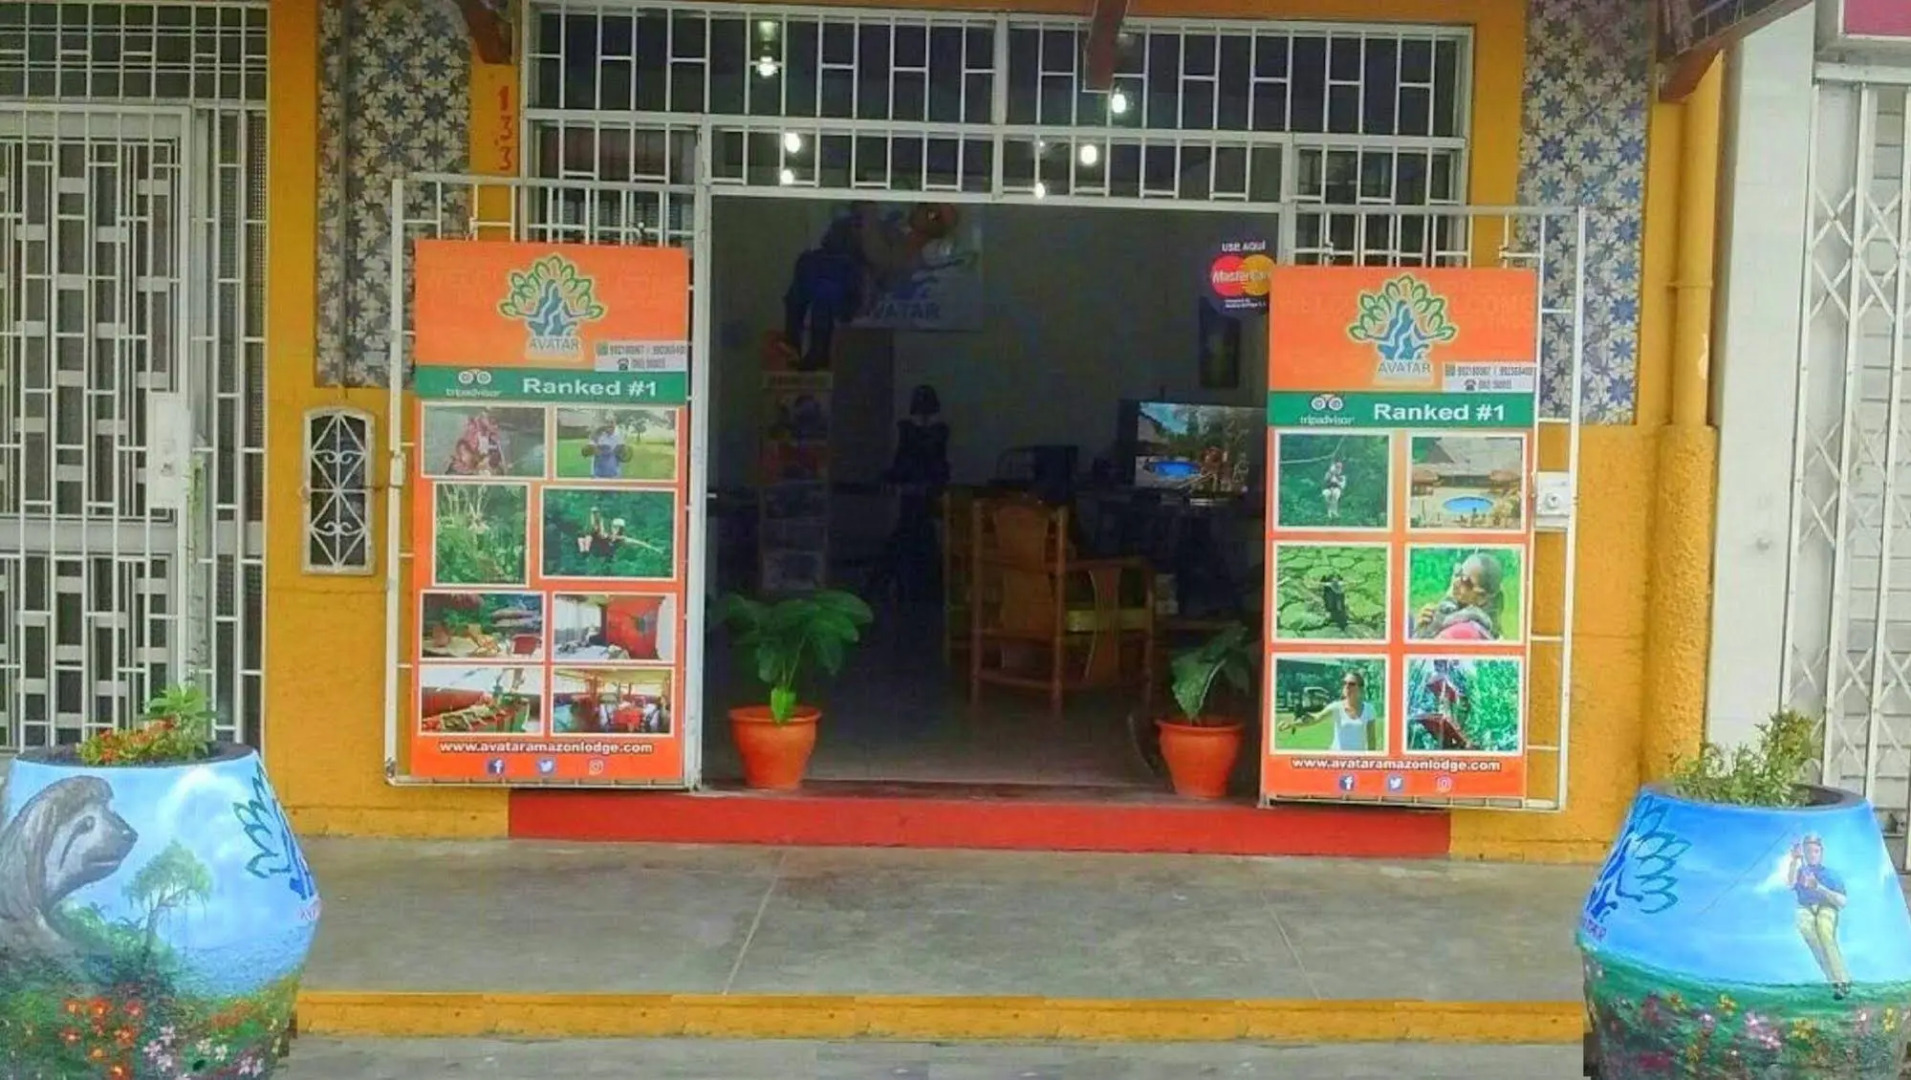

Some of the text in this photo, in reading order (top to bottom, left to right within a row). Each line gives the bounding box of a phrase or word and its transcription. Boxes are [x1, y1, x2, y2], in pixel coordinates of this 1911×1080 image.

[528, 337, 580, 351] AVATAR
[1377, 361, 1431, 375] AVATAR
[523, 377, 657, 397] Ranked #1
[1373, 403, 1505, 421] Ranked #1
[439, 740, 653, 754] www.avataramazonlodge.com
[1291, 757, 1501, 772] www.avataramazonlodge.com
